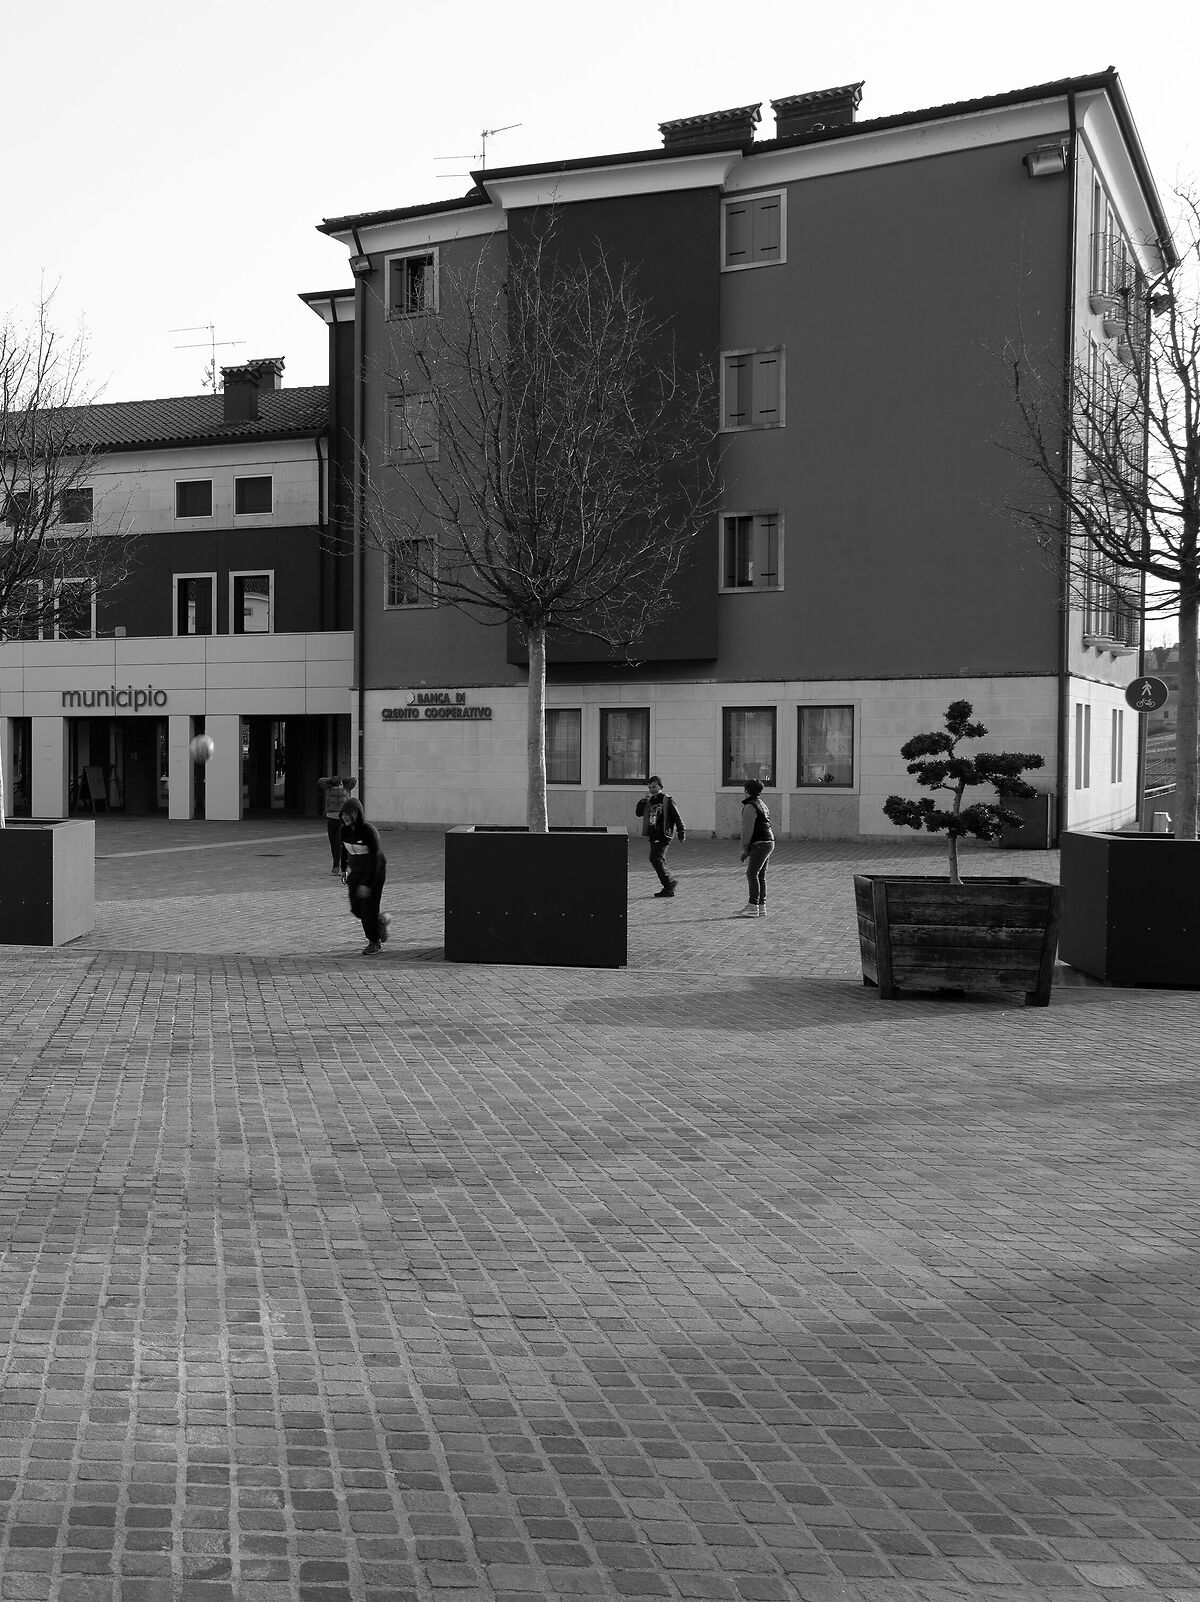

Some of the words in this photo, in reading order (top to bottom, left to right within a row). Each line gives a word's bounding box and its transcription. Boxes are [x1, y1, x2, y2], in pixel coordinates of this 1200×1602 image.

[62, 684, 167, 712] municipio
[416, 692, 450, 704] BANCA
[455, 692, 466, 703] DI
[381, 708, 420, 719] CREDITO
[424, 707, 492, 719] COOPERATIVO
